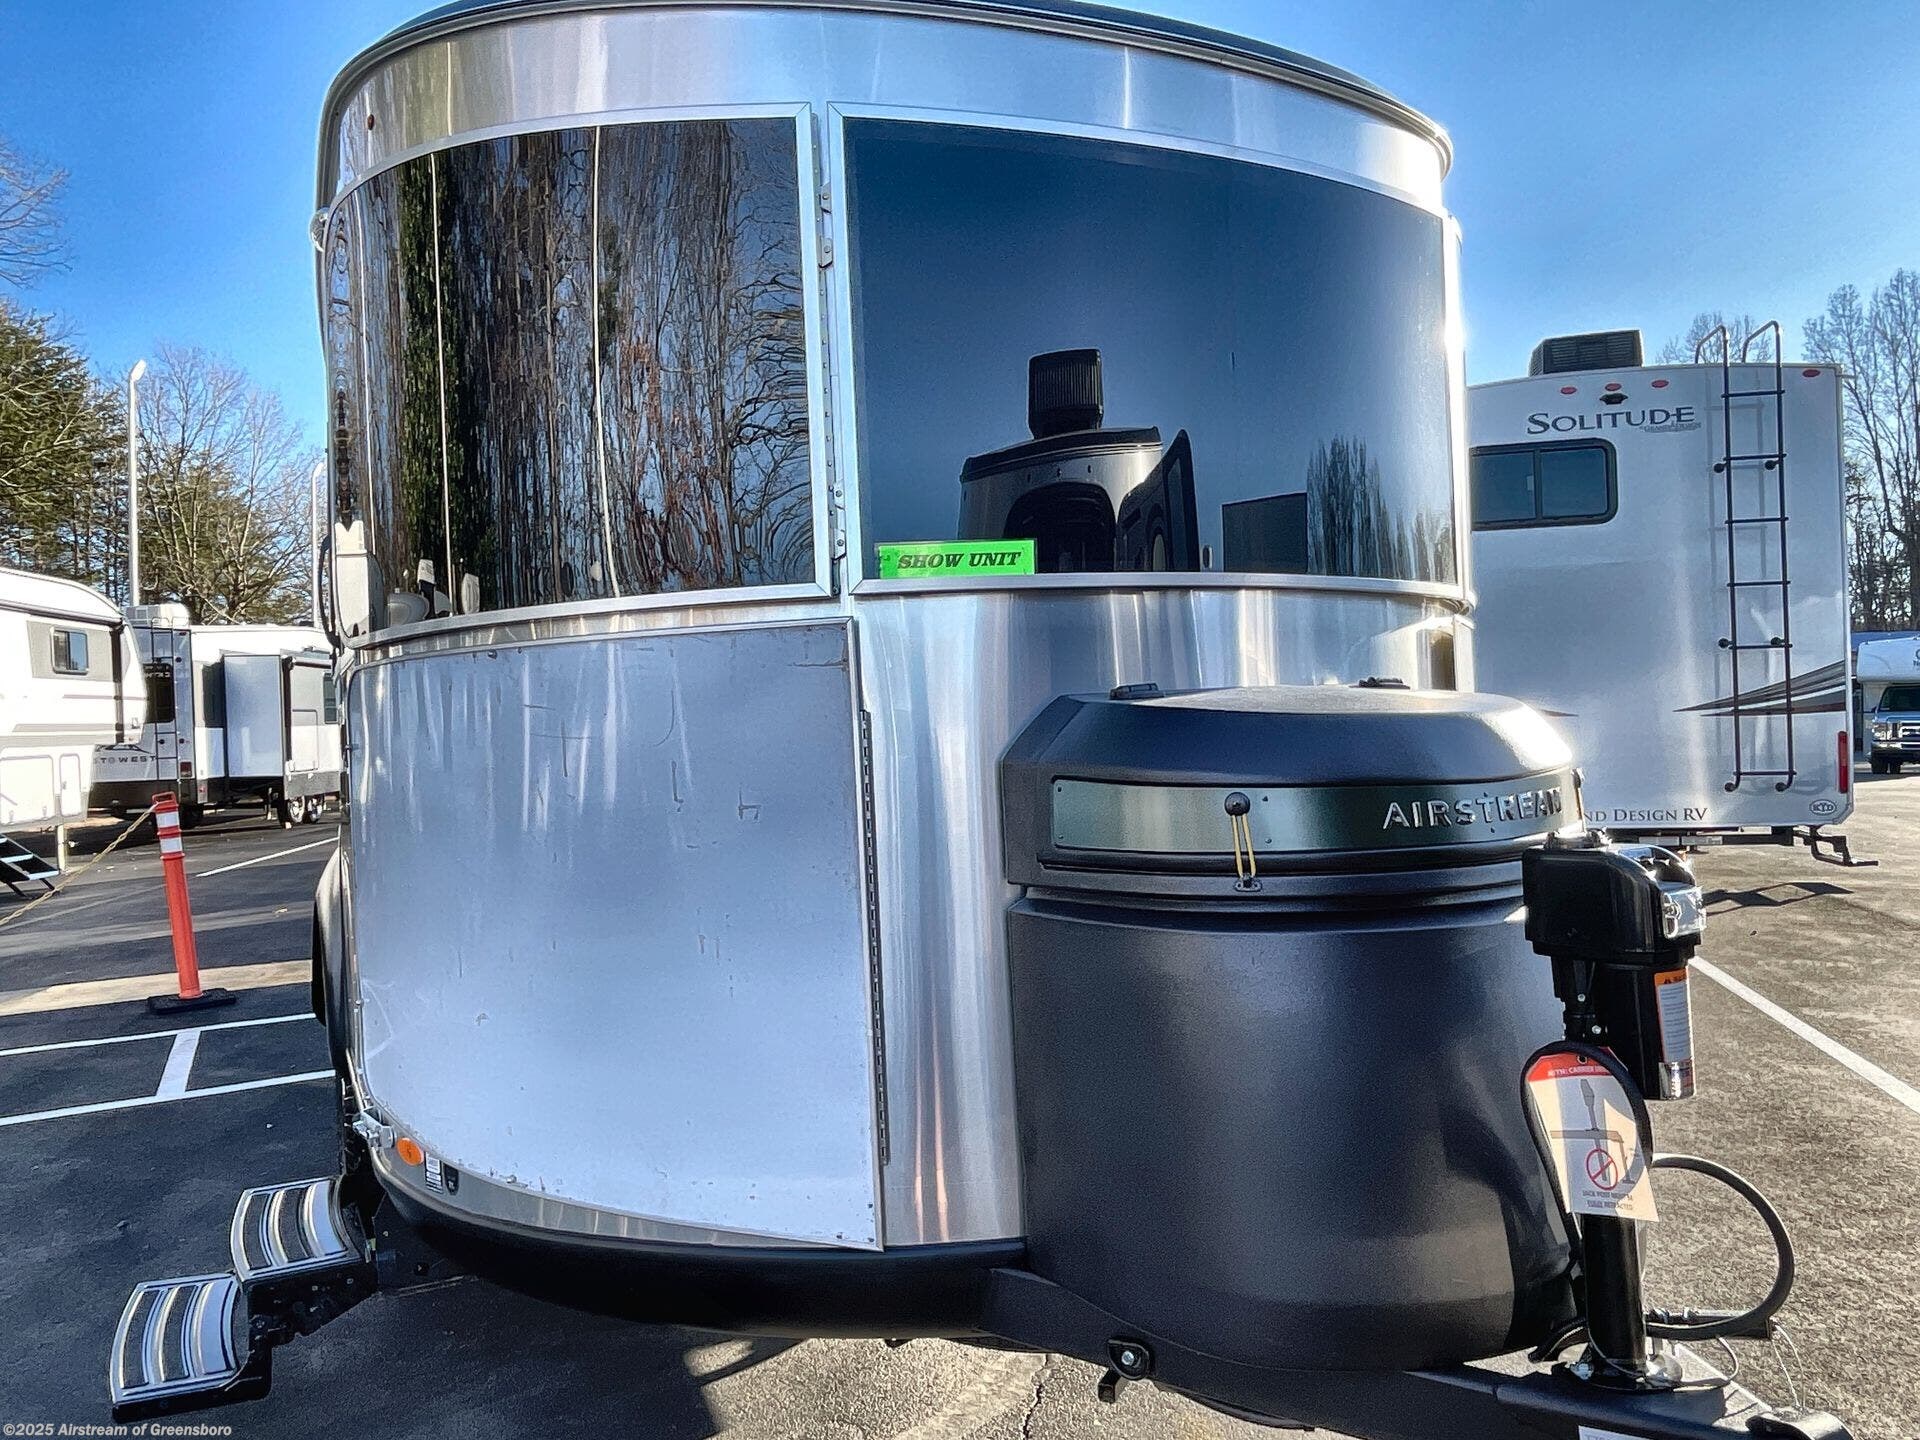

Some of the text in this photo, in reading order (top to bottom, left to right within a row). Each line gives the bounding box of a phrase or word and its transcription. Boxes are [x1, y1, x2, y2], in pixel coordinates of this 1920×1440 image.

[1527, 406, 1695, 435] SOLITUDE
[897, 551, 1022, 569] SHOW UNIT
[1382, 788, 1562, 830] AIRSTREAM
[1614, 808, 1677, 822] DESIGN
[1684, 807, 1708, 821] RV
